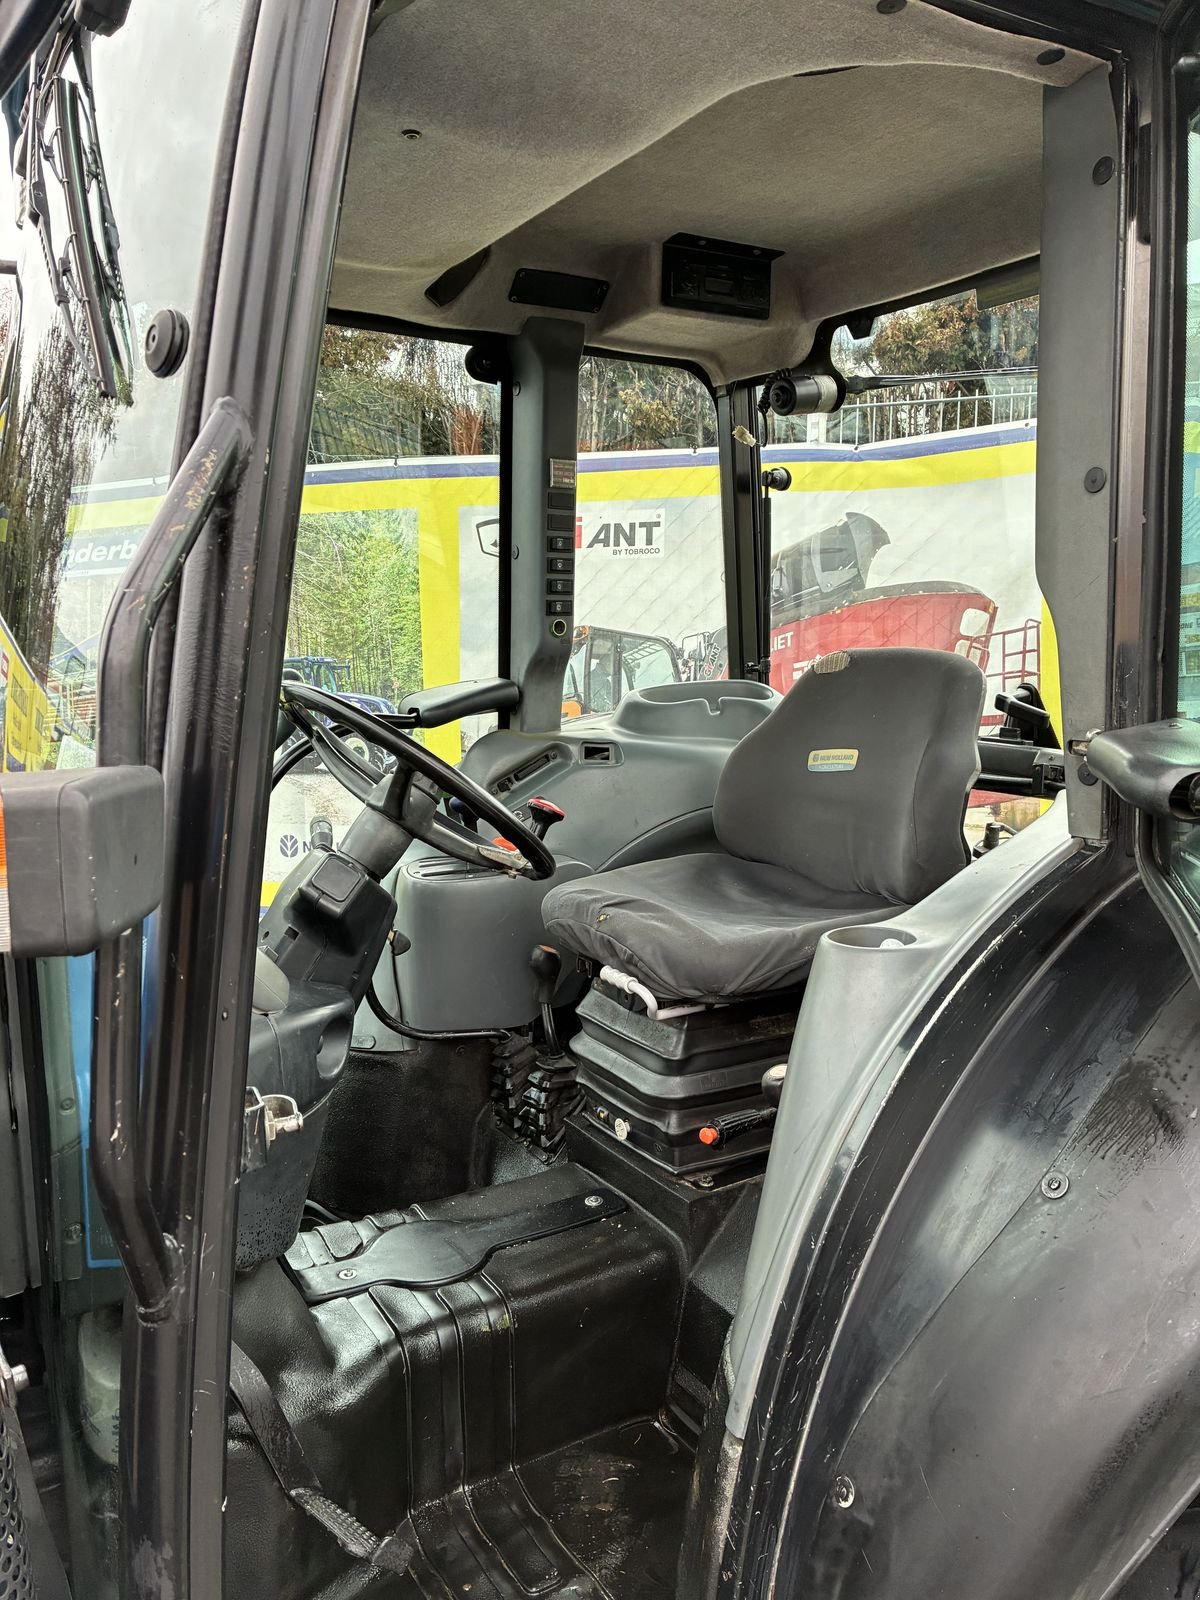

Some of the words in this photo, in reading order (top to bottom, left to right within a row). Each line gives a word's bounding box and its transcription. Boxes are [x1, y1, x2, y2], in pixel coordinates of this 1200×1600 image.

[575, 515, 661, 549] iANT
[64, 540, 137, 563] nderb
[625, 547, 661, 555] TOBROCO
[771, 631, 794, 651] IET
